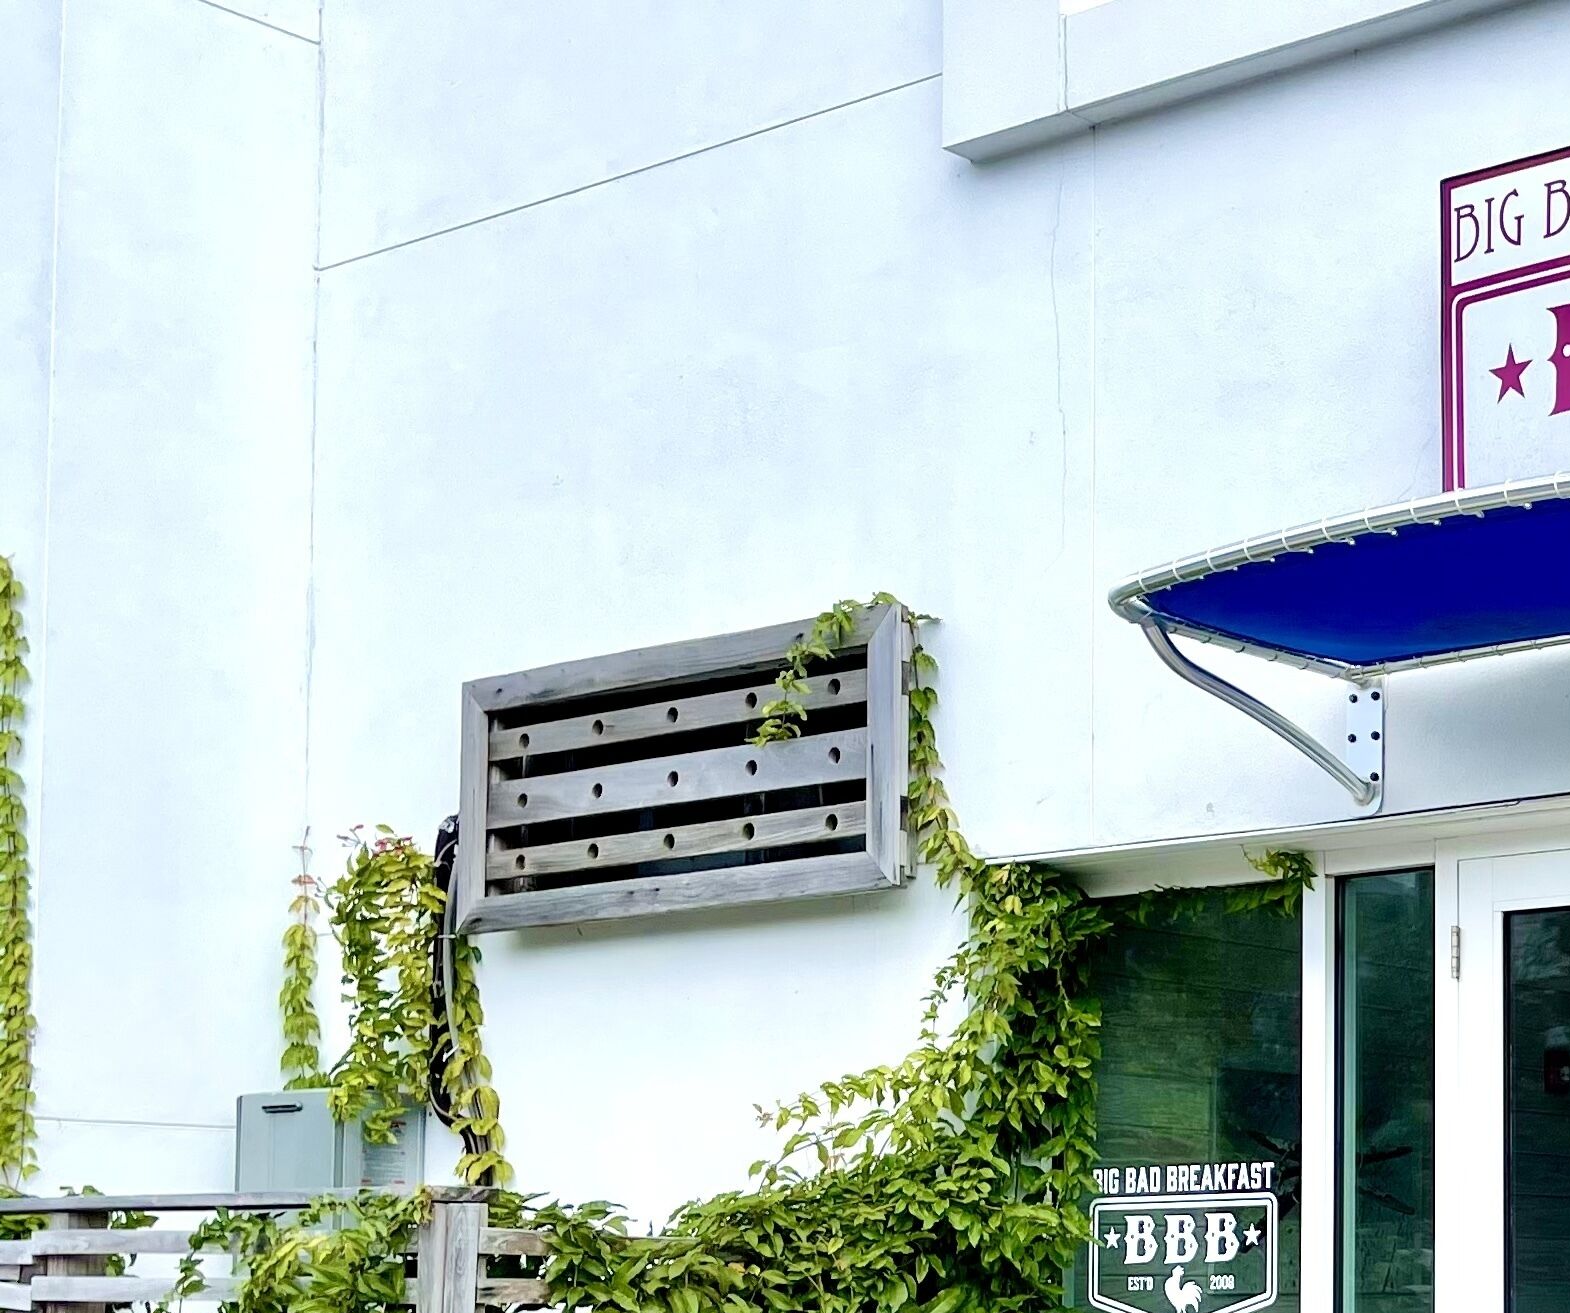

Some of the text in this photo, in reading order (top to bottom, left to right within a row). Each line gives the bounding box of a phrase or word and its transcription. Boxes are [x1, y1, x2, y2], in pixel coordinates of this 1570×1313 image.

[1453, 189, 1524, 263] BIG
[1125, 1166, 1161, 1194] BAD
[1166, 1161, 1275, 1193] BREAKFAST
[1123, 1212, 1240, 1265] BBB
[1209, 1274, 1235, 1291] 2008
